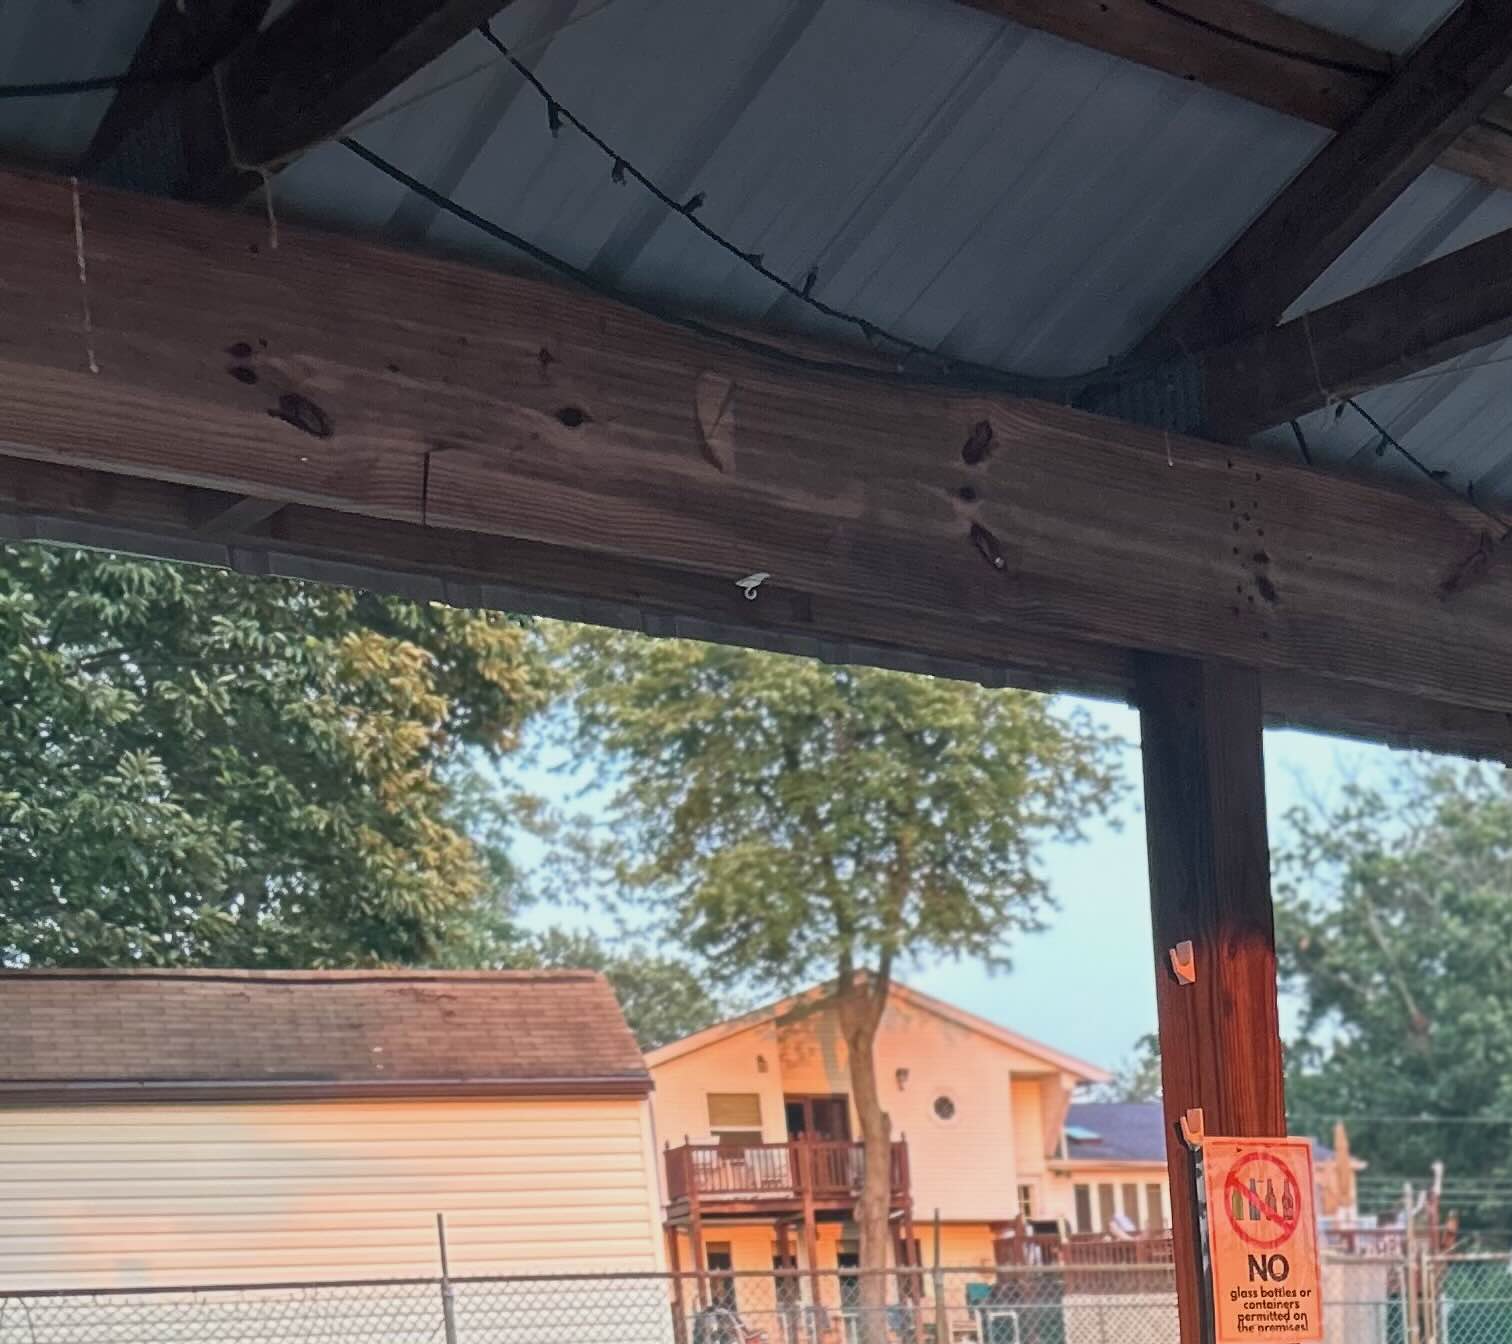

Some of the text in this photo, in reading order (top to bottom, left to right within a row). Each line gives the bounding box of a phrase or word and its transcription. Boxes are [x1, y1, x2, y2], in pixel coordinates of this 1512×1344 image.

[1247, 1253, 1290, 1283] NO
[1230, 1286, 1312, 1302] glass bottles or
[1243, 1299, 1300, 1310] containers
[1237, 1309, 1307, 1322] permitted on
[1237, 1319, 1255, 1332] the
